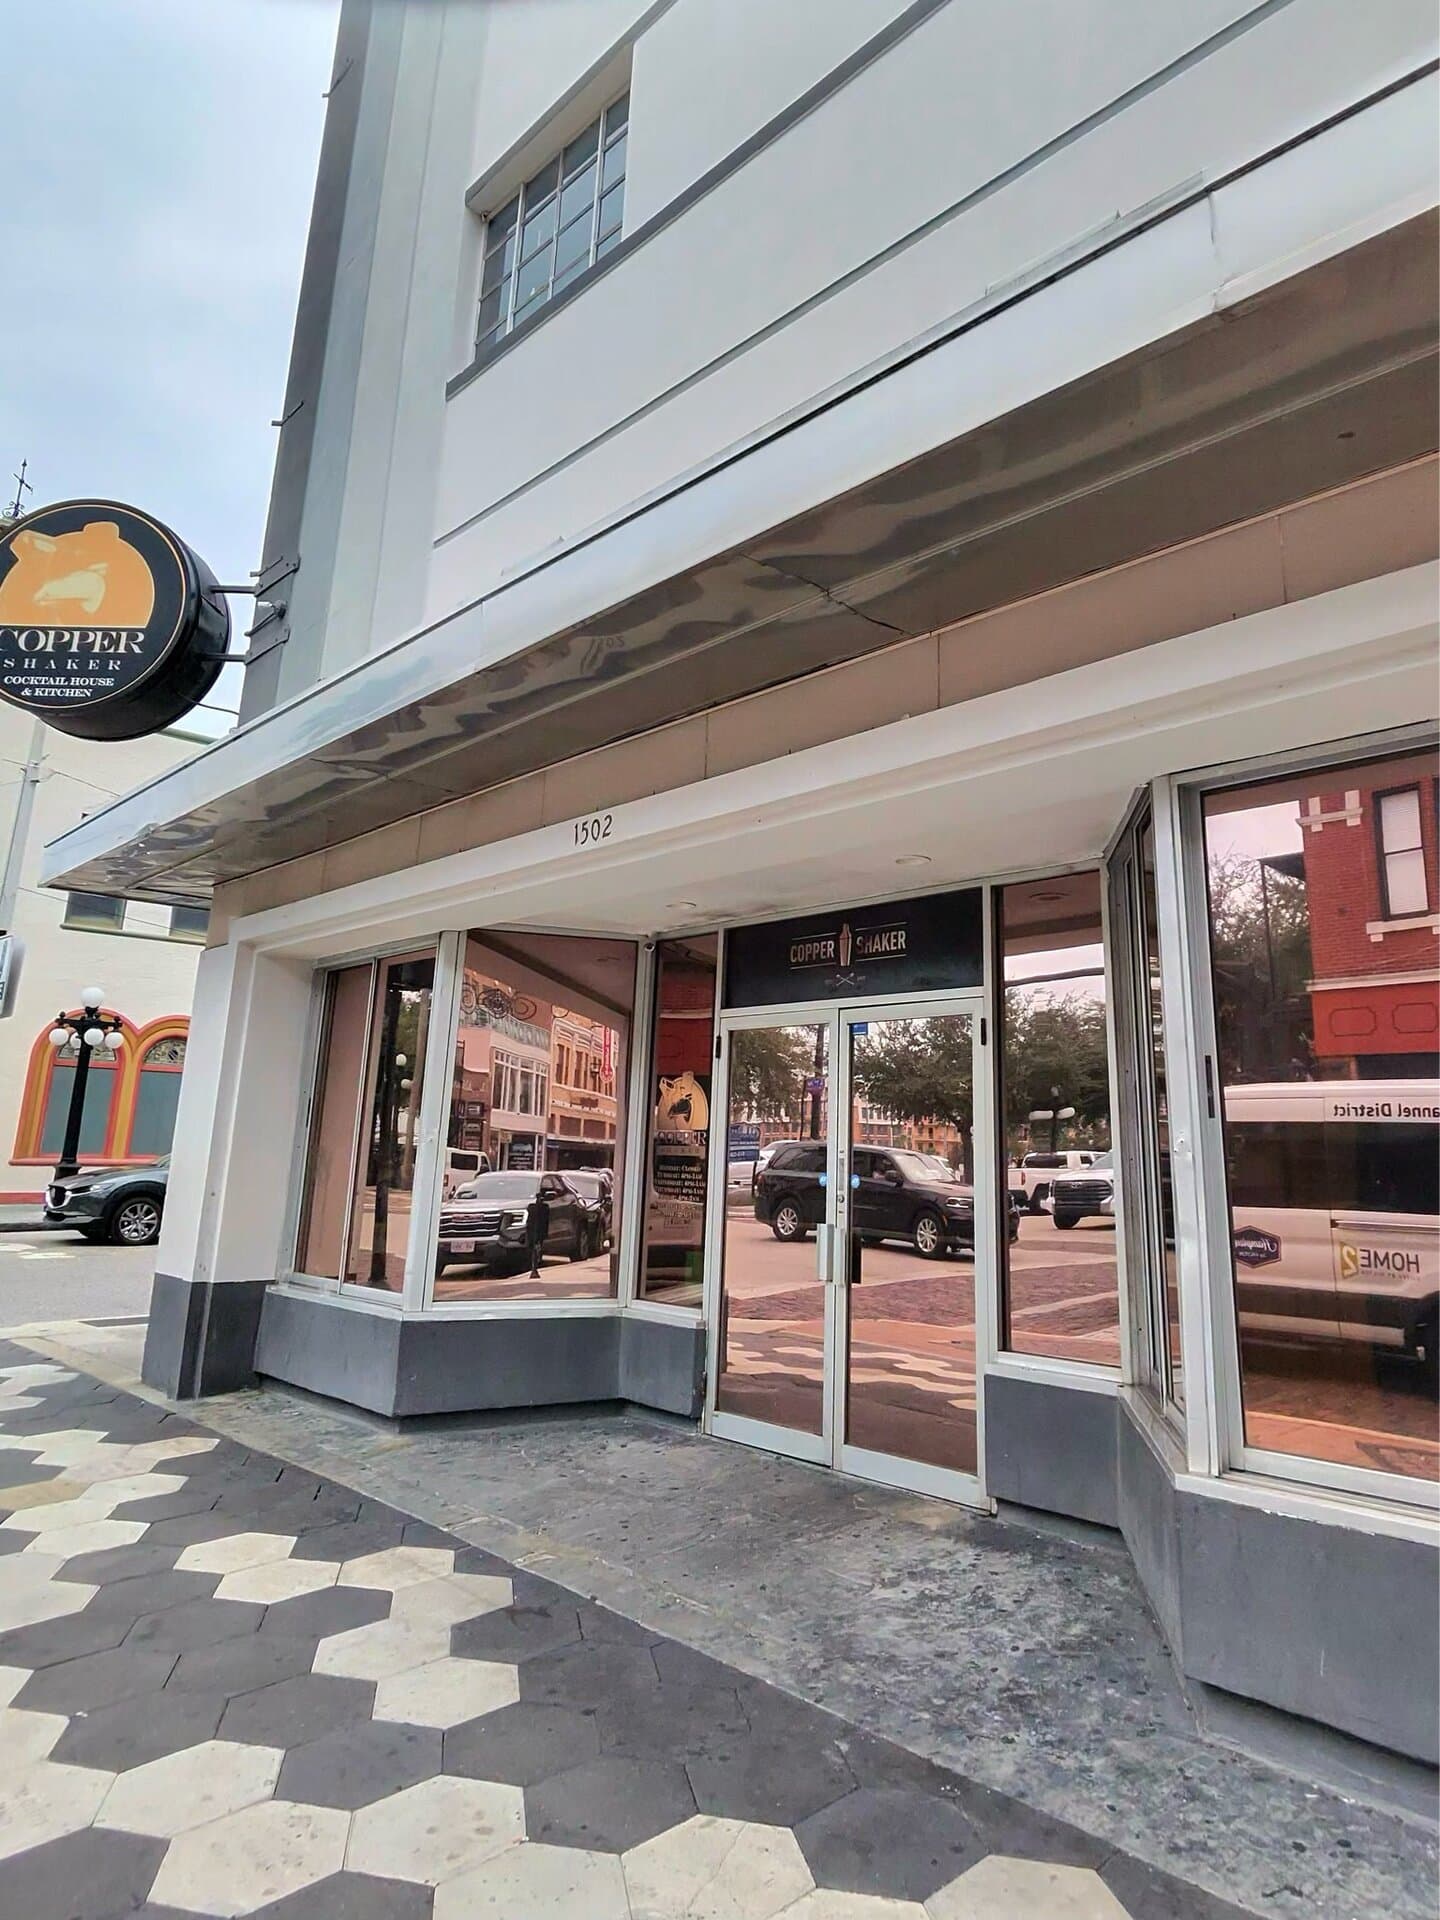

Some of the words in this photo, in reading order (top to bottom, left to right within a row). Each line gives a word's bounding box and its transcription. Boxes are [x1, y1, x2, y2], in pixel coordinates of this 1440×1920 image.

[0, 629, 145, 653] COPPER
[3, 658, 121, 671] SHAKER
[4, 675, 68, 686] COCKTAIL
[69, 677, 115, 687] HOUSE
[20, 687, 32, 697] &
[33, 687, 93, 697] KITCHEN
[574, 814, 612, 846] 1502
[790, 940, 835, 963] COPPER
[856, 930, 906, 954] SHAKER
